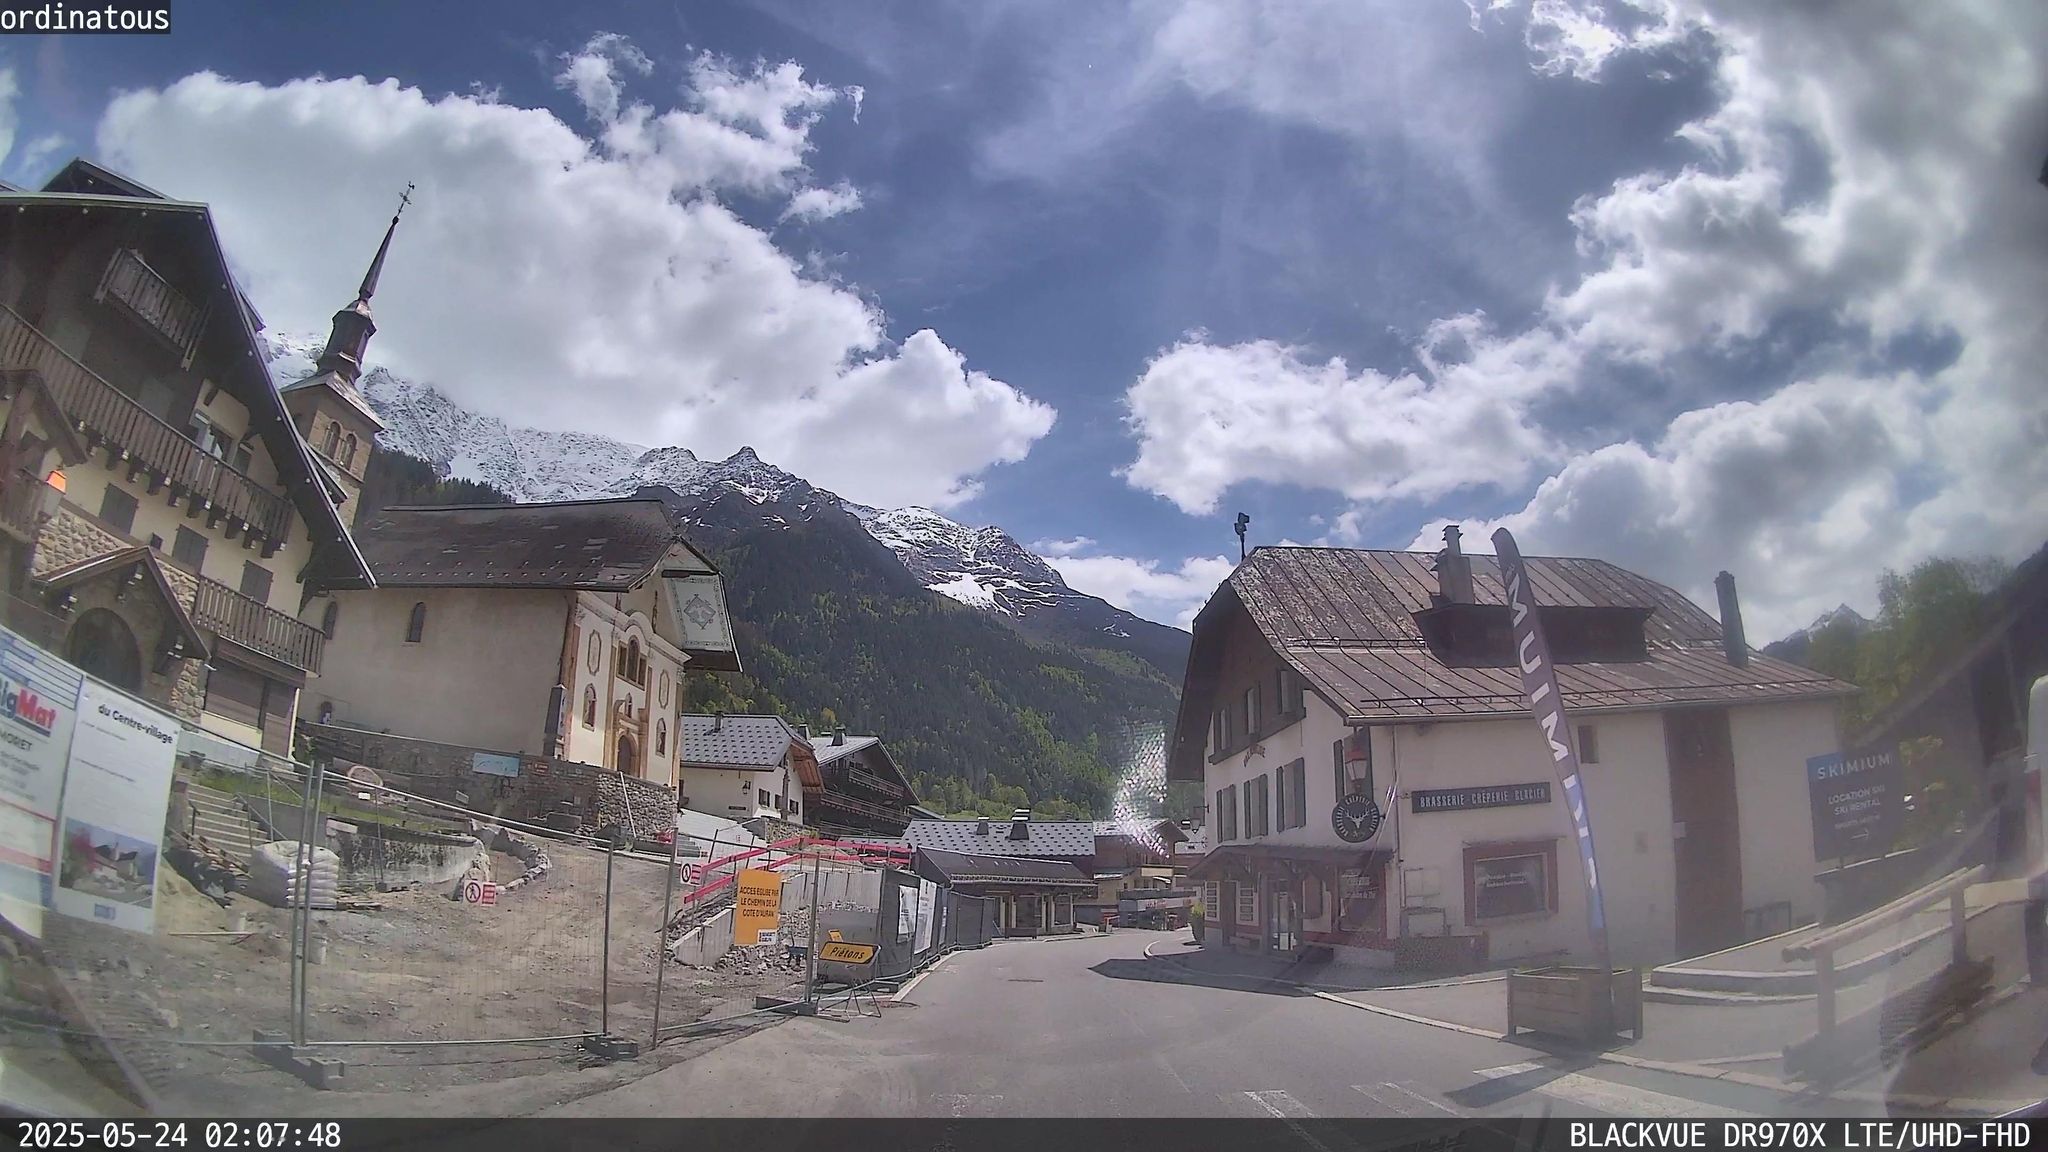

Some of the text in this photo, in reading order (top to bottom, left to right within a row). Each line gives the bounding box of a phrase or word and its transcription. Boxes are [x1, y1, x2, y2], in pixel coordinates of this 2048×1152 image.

[0, 679, 56, 729] igMat
[98, 704, 111, 715] du
[112, 710, 174, 744] Centre-village
[1818, 753, 1890, 779] SKIMIUM
[1420, 793, 1465, 808] BRASSERIE
[1514, 788, 1545, 801] GLACIER
[1828, 788, 1870, 804] LOCATION
[1834, 805, 1848, 816] SKI
[740, 897, 747, 906] LE
[747, 898, 765, 906] CHEMIN
[766, 899, 771, 907] DE
[830, 946, 865, 960] Piétons
